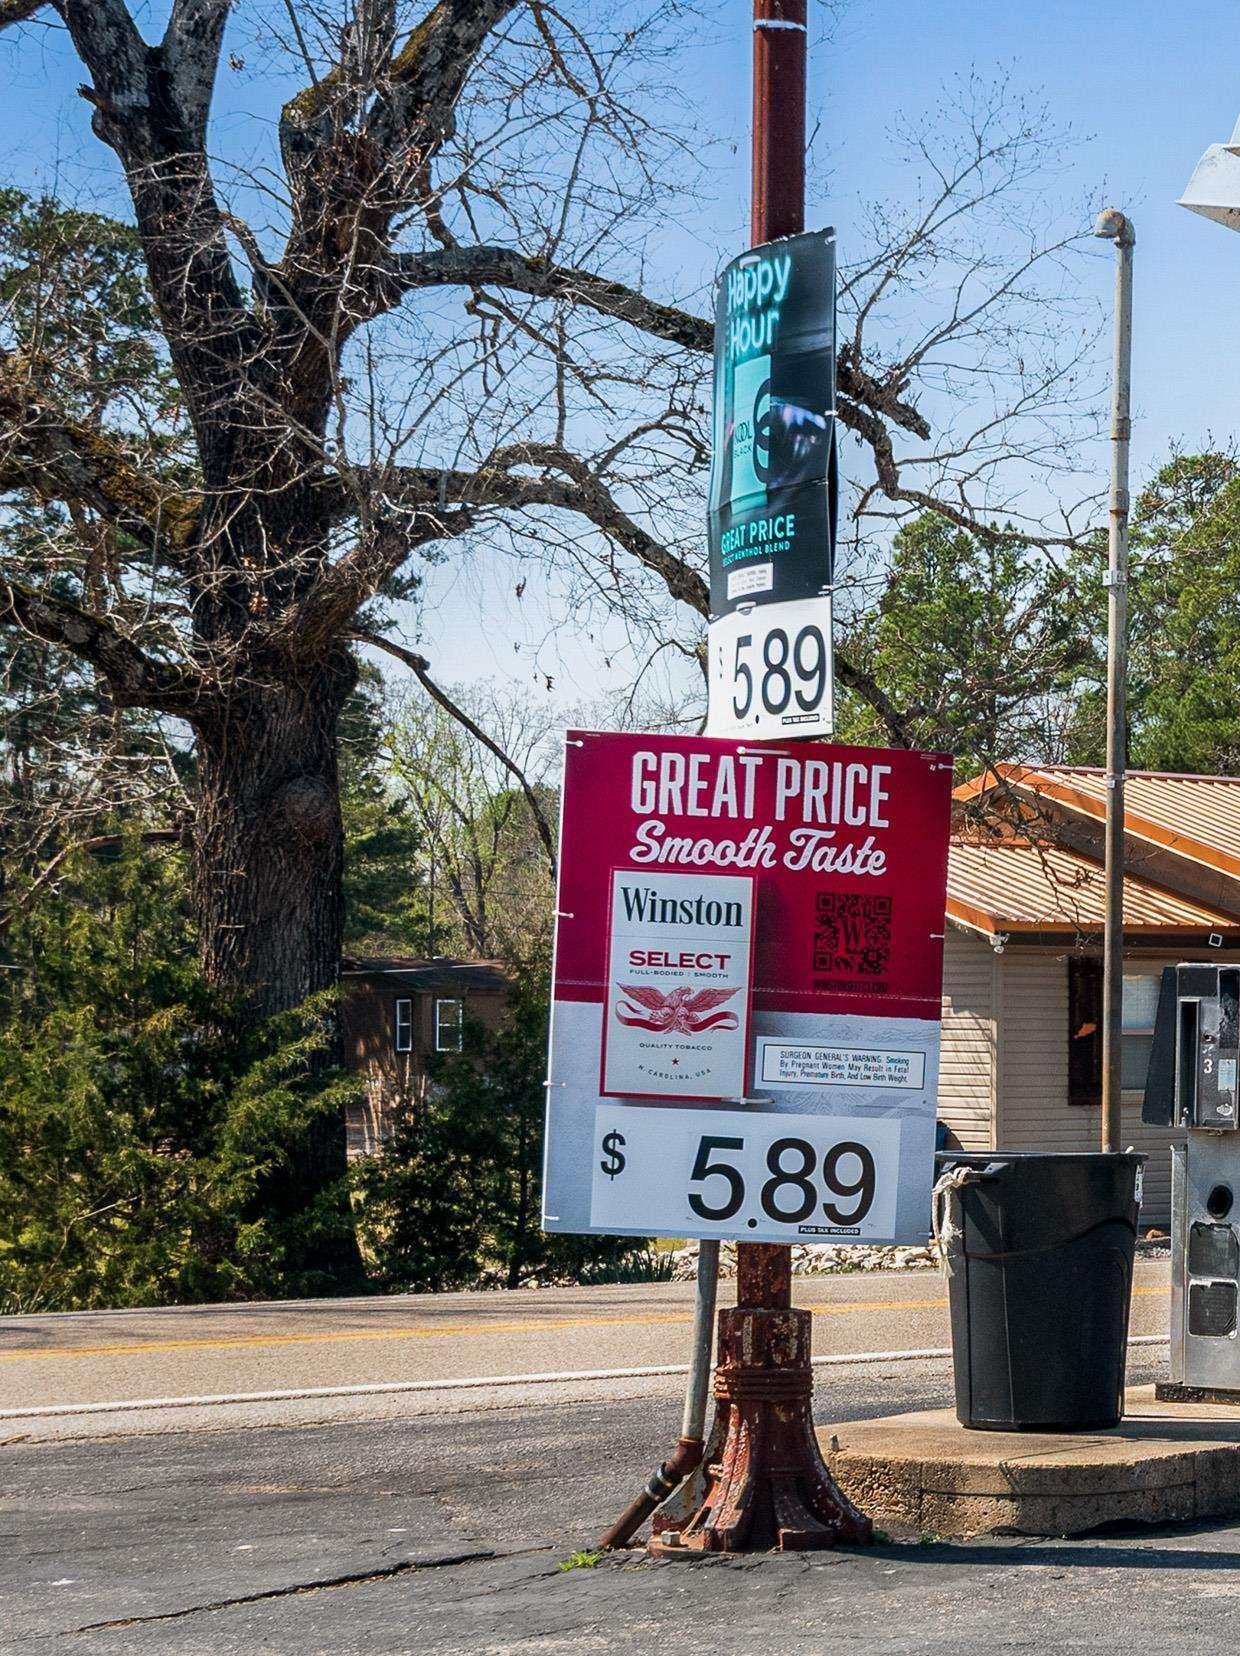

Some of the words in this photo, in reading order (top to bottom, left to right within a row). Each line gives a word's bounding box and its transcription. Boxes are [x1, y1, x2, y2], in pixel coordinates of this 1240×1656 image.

[727, 255, 791, 314] Happy
[730, 309, 779, 360] Hour
[721, 524, 746, 555] GREAT
[750, 513, 795, 544] PRICE
[764, 540, 791, 554] BLEND
[733, 624, 827, 724] 5.89
[630, 751, 763, 819] GREAT
[775, 758, 892, 828] PRICE
[629, 819, 777, 869] Smooth
[783, 827, 887, 877] Taste
[620, 886, 743, 928] Winston
[628, 950, 731, 970] SELECT
[780, 1051, 811, 1060] SURGEON
[815, 1051, 849, 1061] GENERAL'S
[791, 1060, 820, 1070] Pregnant
[821, 1062, 846, 1070] Women
[848, 1063, 861, 1072] May
[847, 1072, 859, 1080] And
[860, 1073, 872, 1081] Low
[873, 1073, 887, 1081] Birth
[1203, 1058, 1214, 1074] 3
[600, 1129, 626, 1181] $
[688, 1135, 876, 1229] 5.89
[800, 1226, 816, 1234] PLUS
